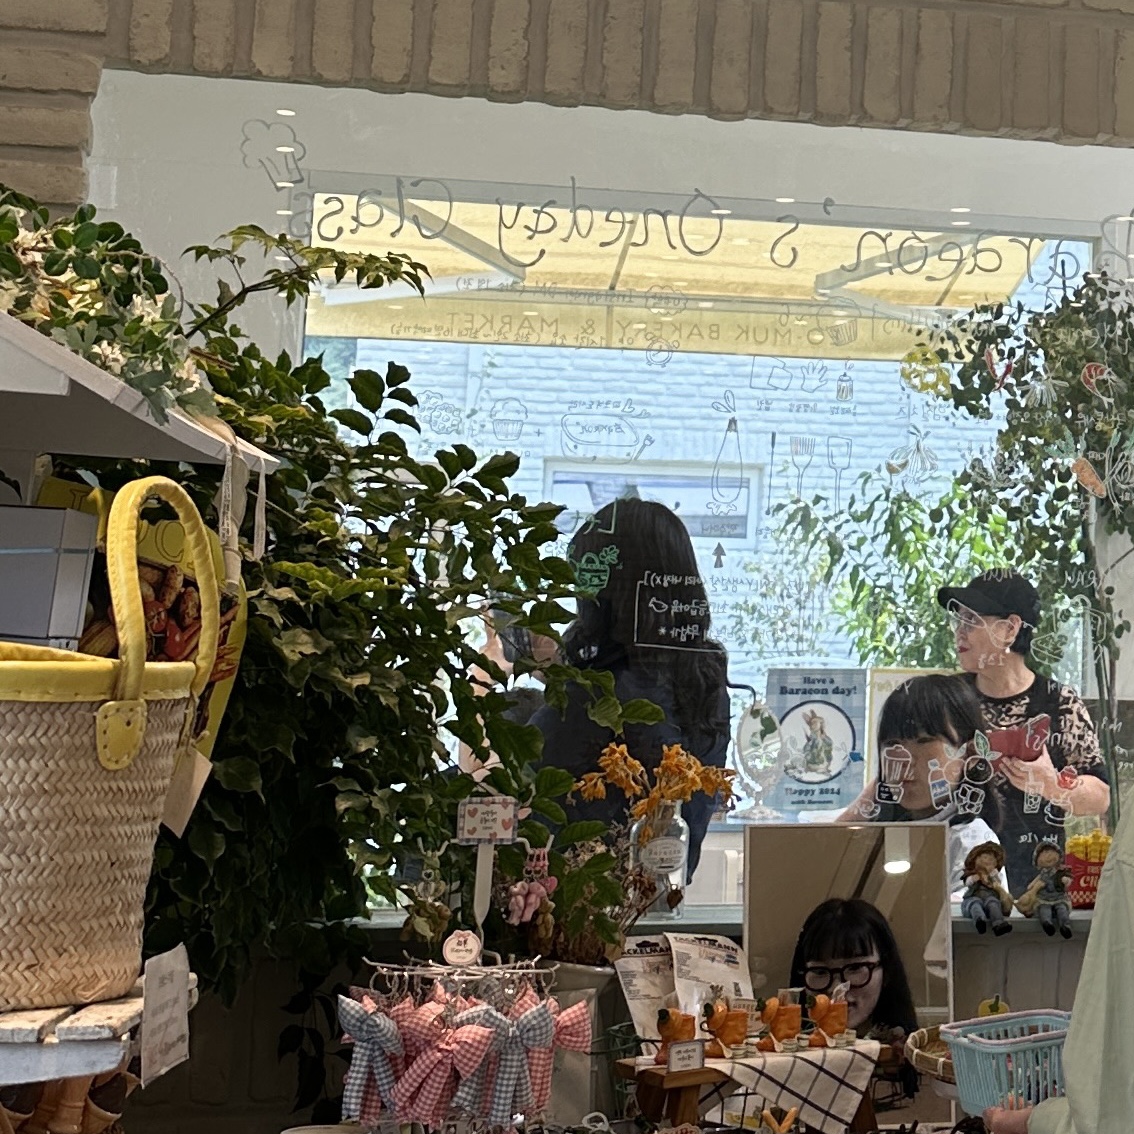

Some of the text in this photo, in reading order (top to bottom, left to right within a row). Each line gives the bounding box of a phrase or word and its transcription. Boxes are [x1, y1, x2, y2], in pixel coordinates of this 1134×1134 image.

[802, 676, 828, 685] Have
[831, 685, 858, 698] day!
[784, 787, 817, 798] Happy
